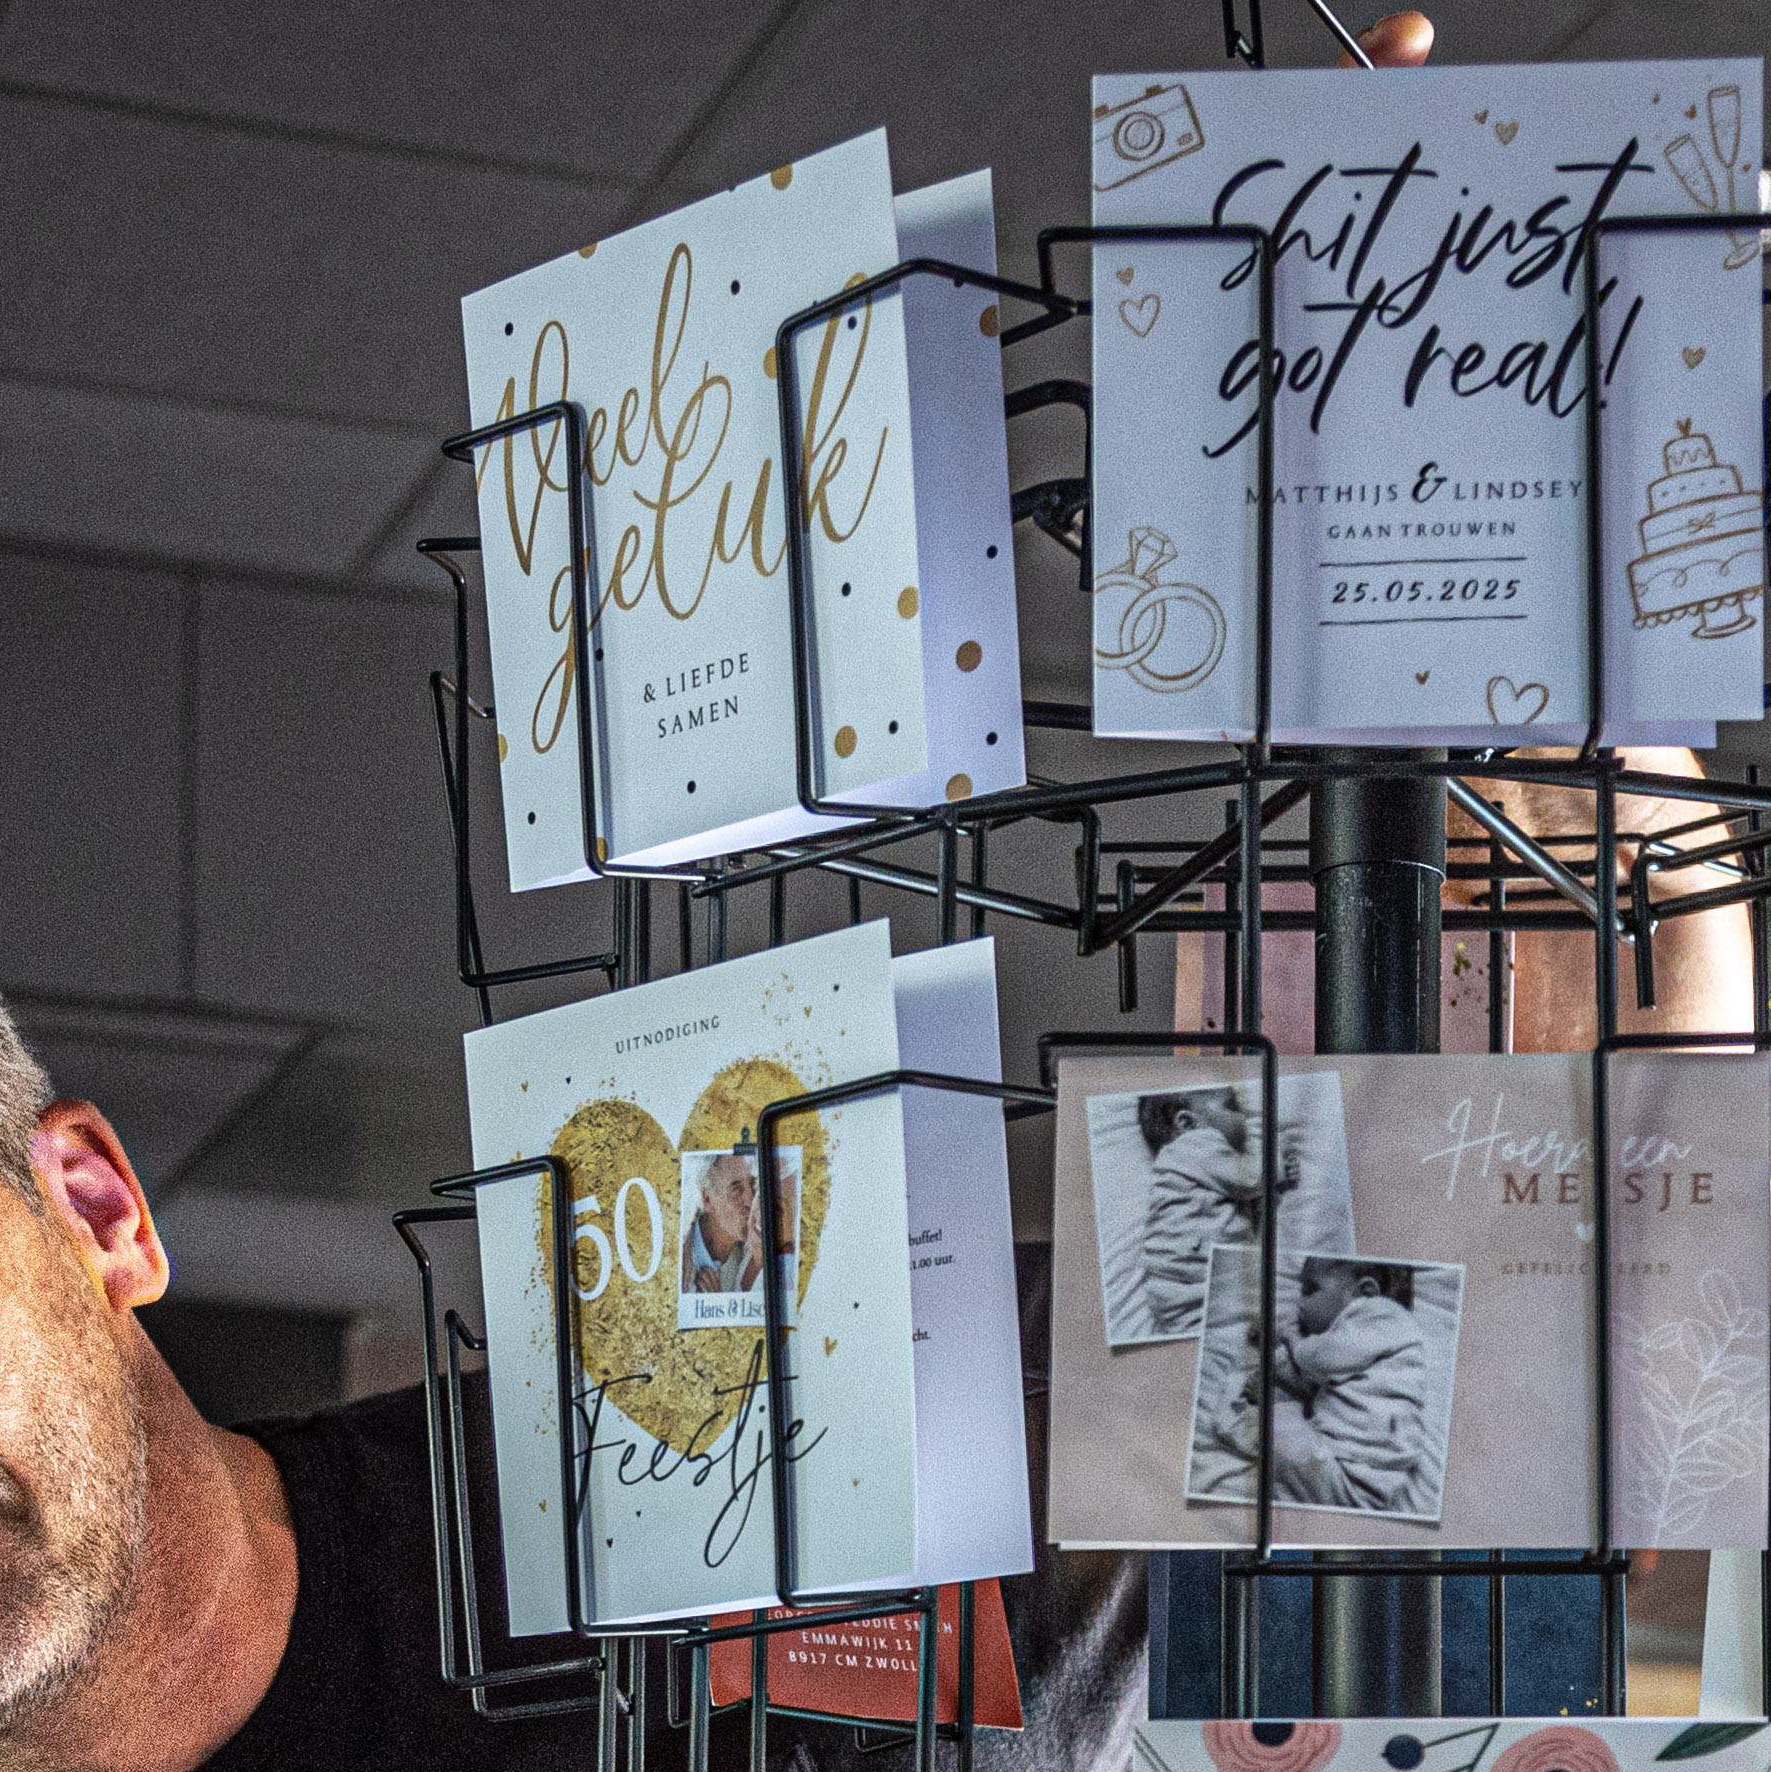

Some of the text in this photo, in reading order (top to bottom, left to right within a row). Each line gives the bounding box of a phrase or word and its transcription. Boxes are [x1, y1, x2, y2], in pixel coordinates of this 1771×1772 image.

[1212, 137, 1655, 328] Shit just
[1201, 276, 1644, 458] got real!
[477, 242, 709, 577] Veel
[1410, 460, 1448, 504] &
[1453, 480, 1584, 500] LINDSEY
[532, 271, 888, 755] geluk
[1328, 521, 1517, 540] GAAN TROUWEN
[1331, 578, 1522, 604] 25.05.2025
[643, 651, 750, 704] & LIEFDE
[657, 694, 739, 739] SAMEN
[615, 1014, 721, 1055] UITNODIGING
[1502, 1171, 1714, 1212] MESJE
[570, 1176, 665, 1301] 50
[694, 1298, 725, 1320] Hans
[572, 1338, 829, 1569] Feestje
[801, 1631, 888, 1651] EMMAWIJK
[834, 1653, 859, 1668] CM
[865, 1656, 918, 1672] ZWOLL
